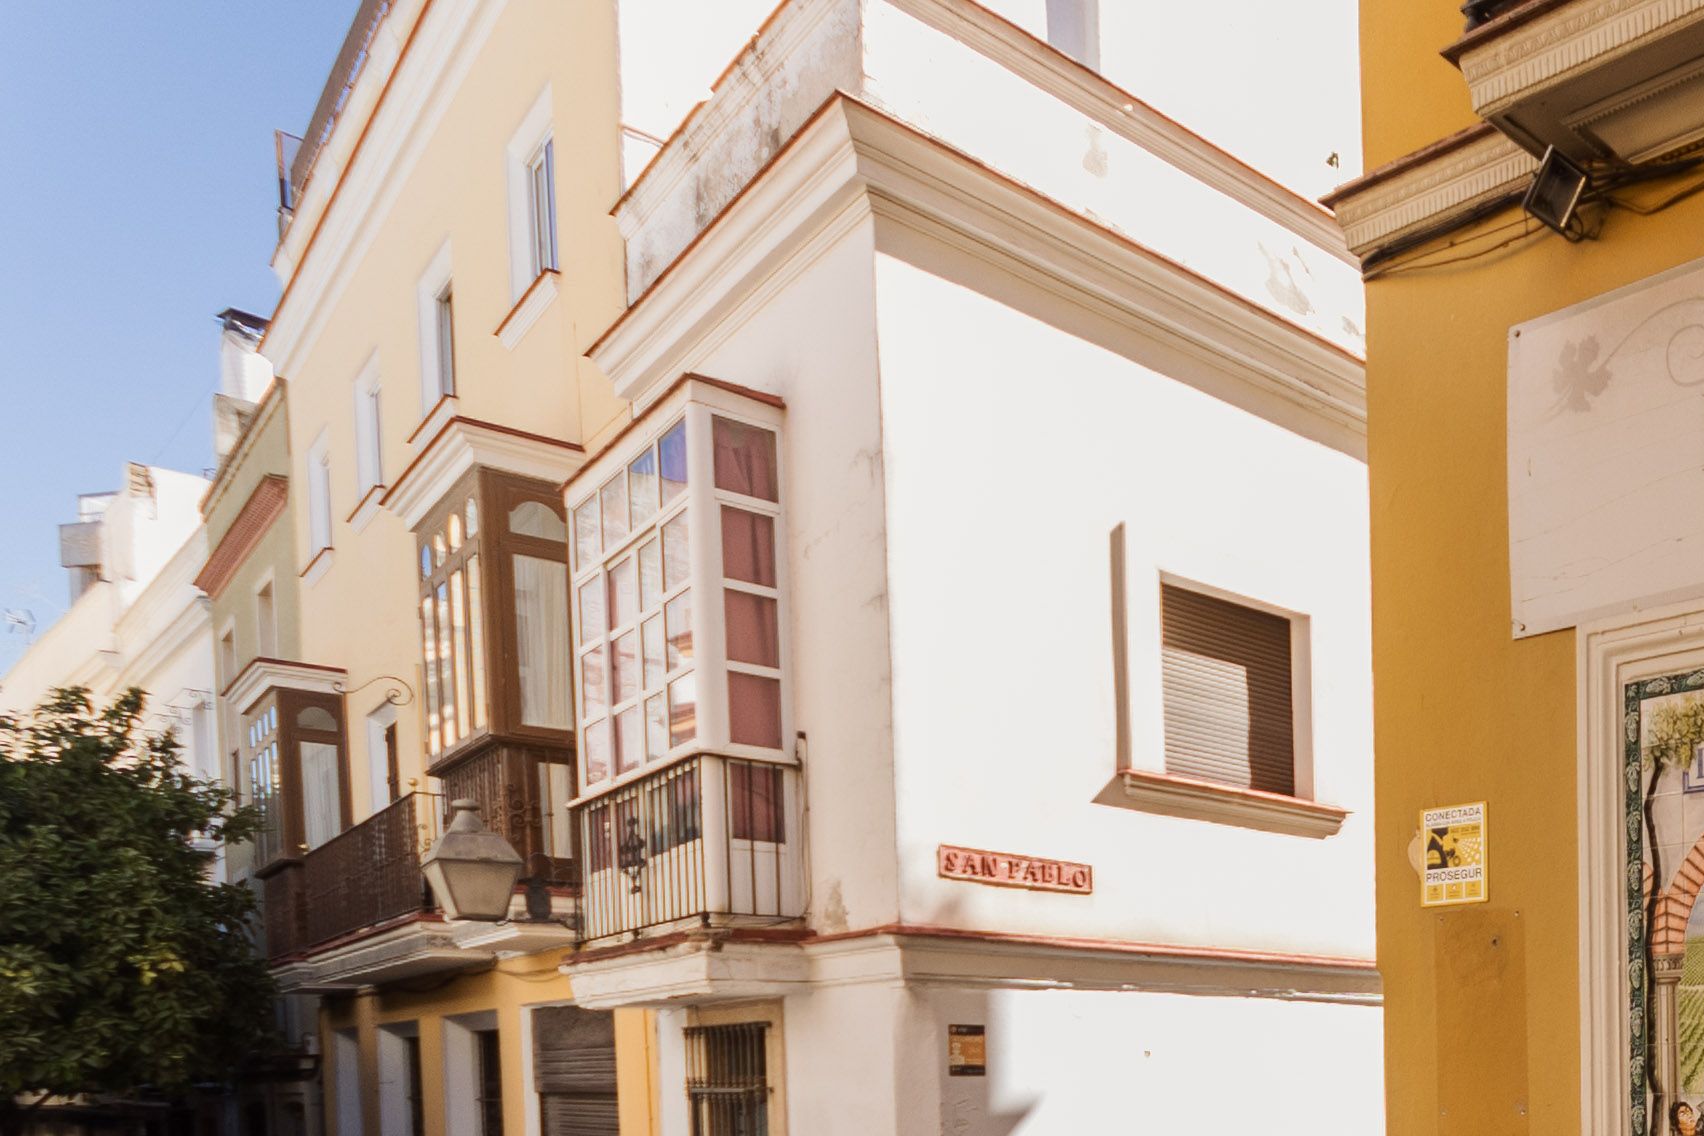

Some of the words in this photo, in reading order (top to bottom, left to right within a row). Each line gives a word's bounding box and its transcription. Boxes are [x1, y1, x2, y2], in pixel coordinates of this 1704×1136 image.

[1425, 807, 1482, 823] CONECTADA
[944, 851, 998, 878] SAN
[1007, 860, 1087, 889] PABLO
[1426, 867, 1482, 882] PROSEGUR
